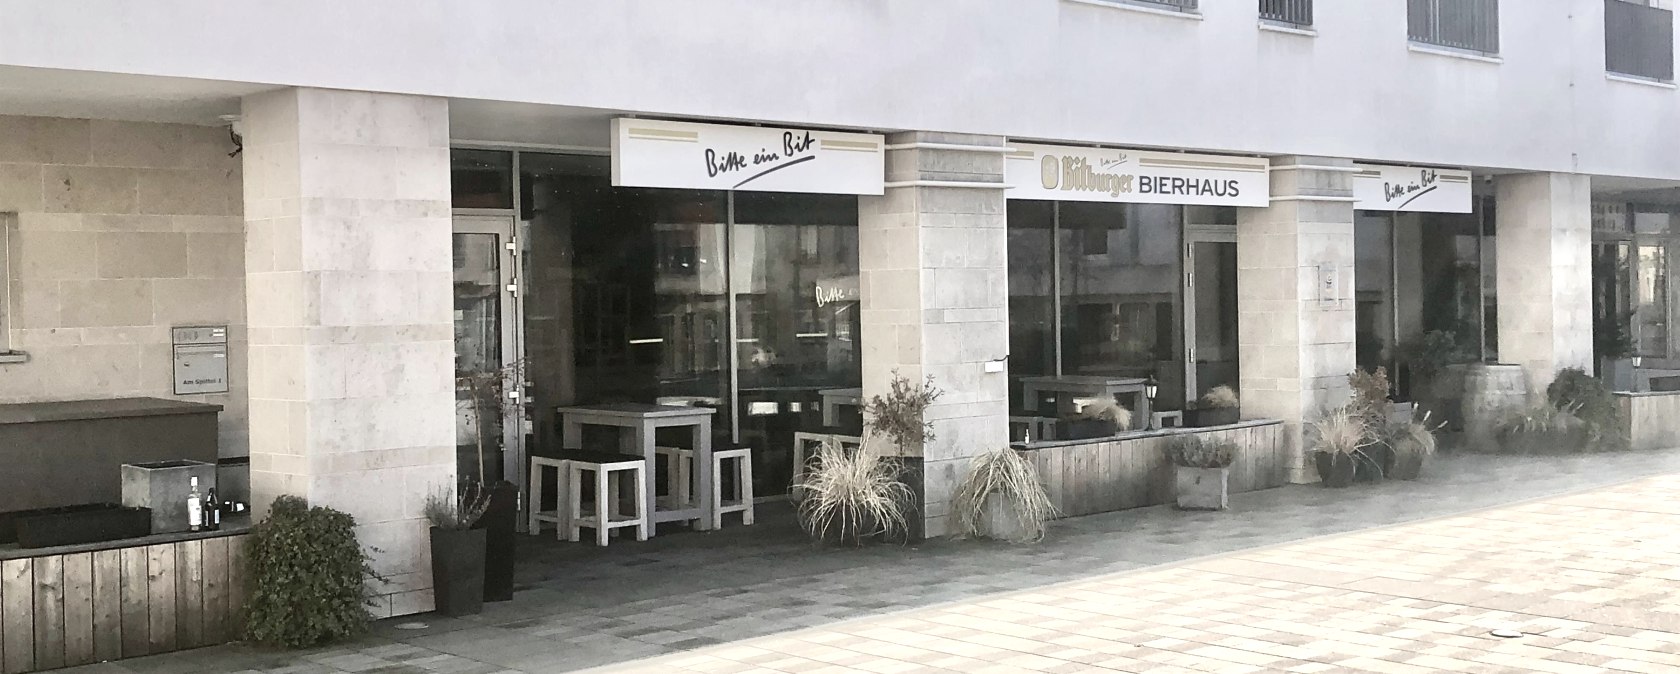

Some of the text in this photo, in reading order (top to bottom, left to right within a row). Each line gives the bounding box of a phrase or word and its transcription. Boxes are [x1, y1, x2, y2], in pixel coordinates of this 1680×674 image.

[705, 130, 816, 178] Bitte ein Bit
[1061, 155, 1135, 198] Bitburger
[1138, 175, 1241, 198] BIERHAUS
[1384, 169, 1438, 202] Bitte ein Bit
[815, 285, 845, 308] Bitte
